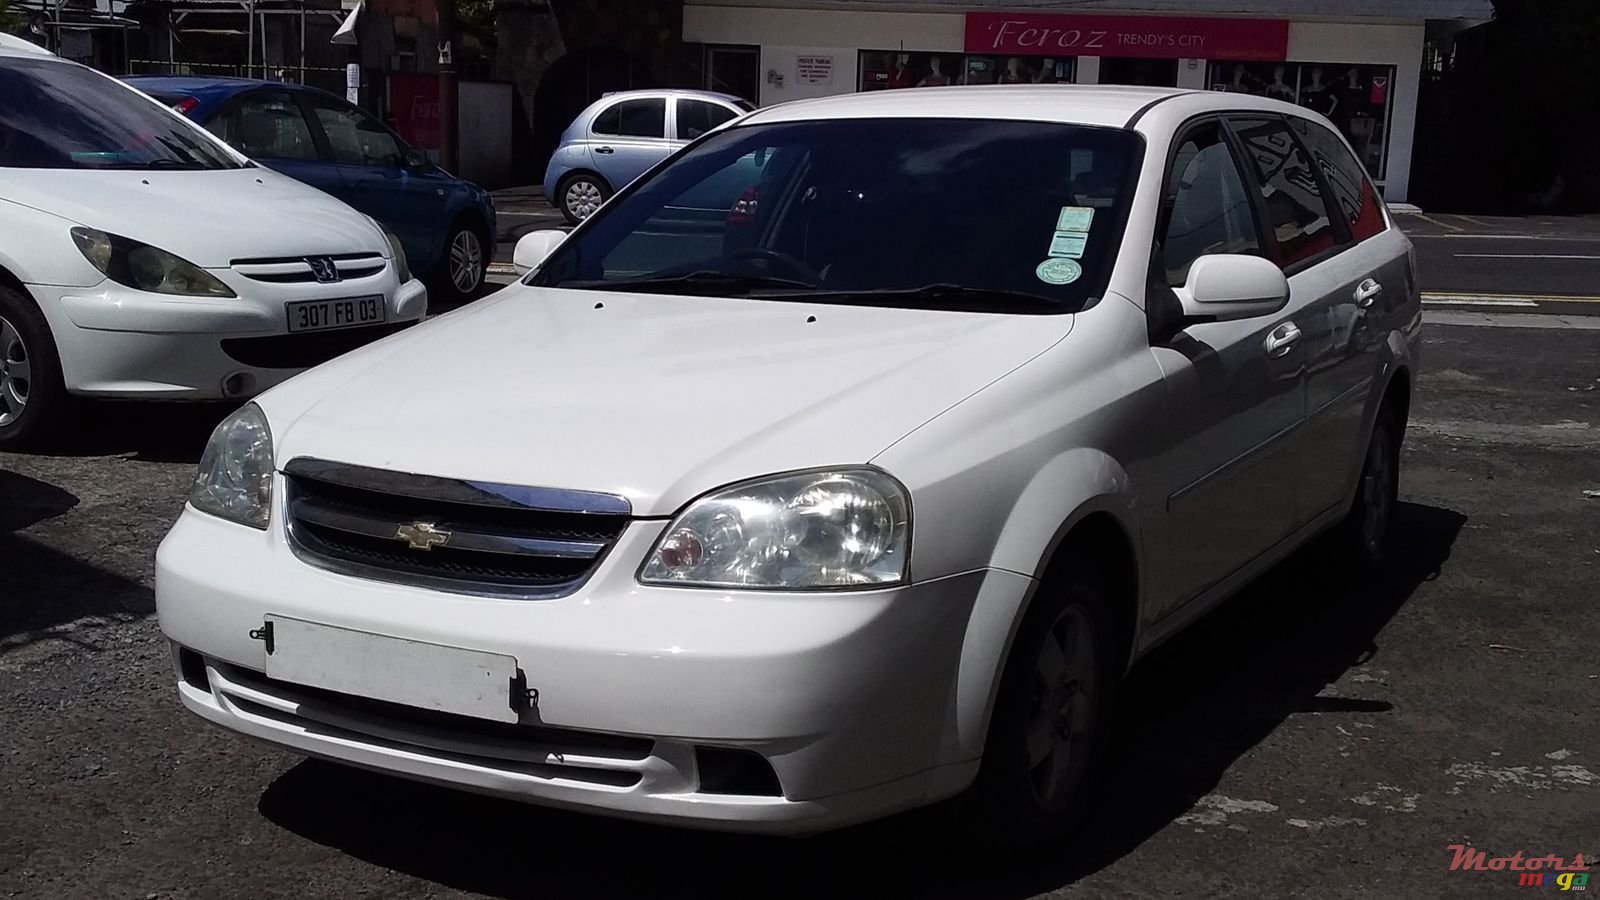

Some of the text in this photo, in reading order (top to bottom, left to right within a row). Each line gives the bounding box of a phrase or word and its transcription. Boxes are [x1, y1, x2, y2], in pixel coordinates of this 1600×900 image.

[988, 20, 1107, 49] Feroz
[1117, 33, 1207, 48] TRENDY'S CITY
[298, 299, 377, 328] 307 FB 03
